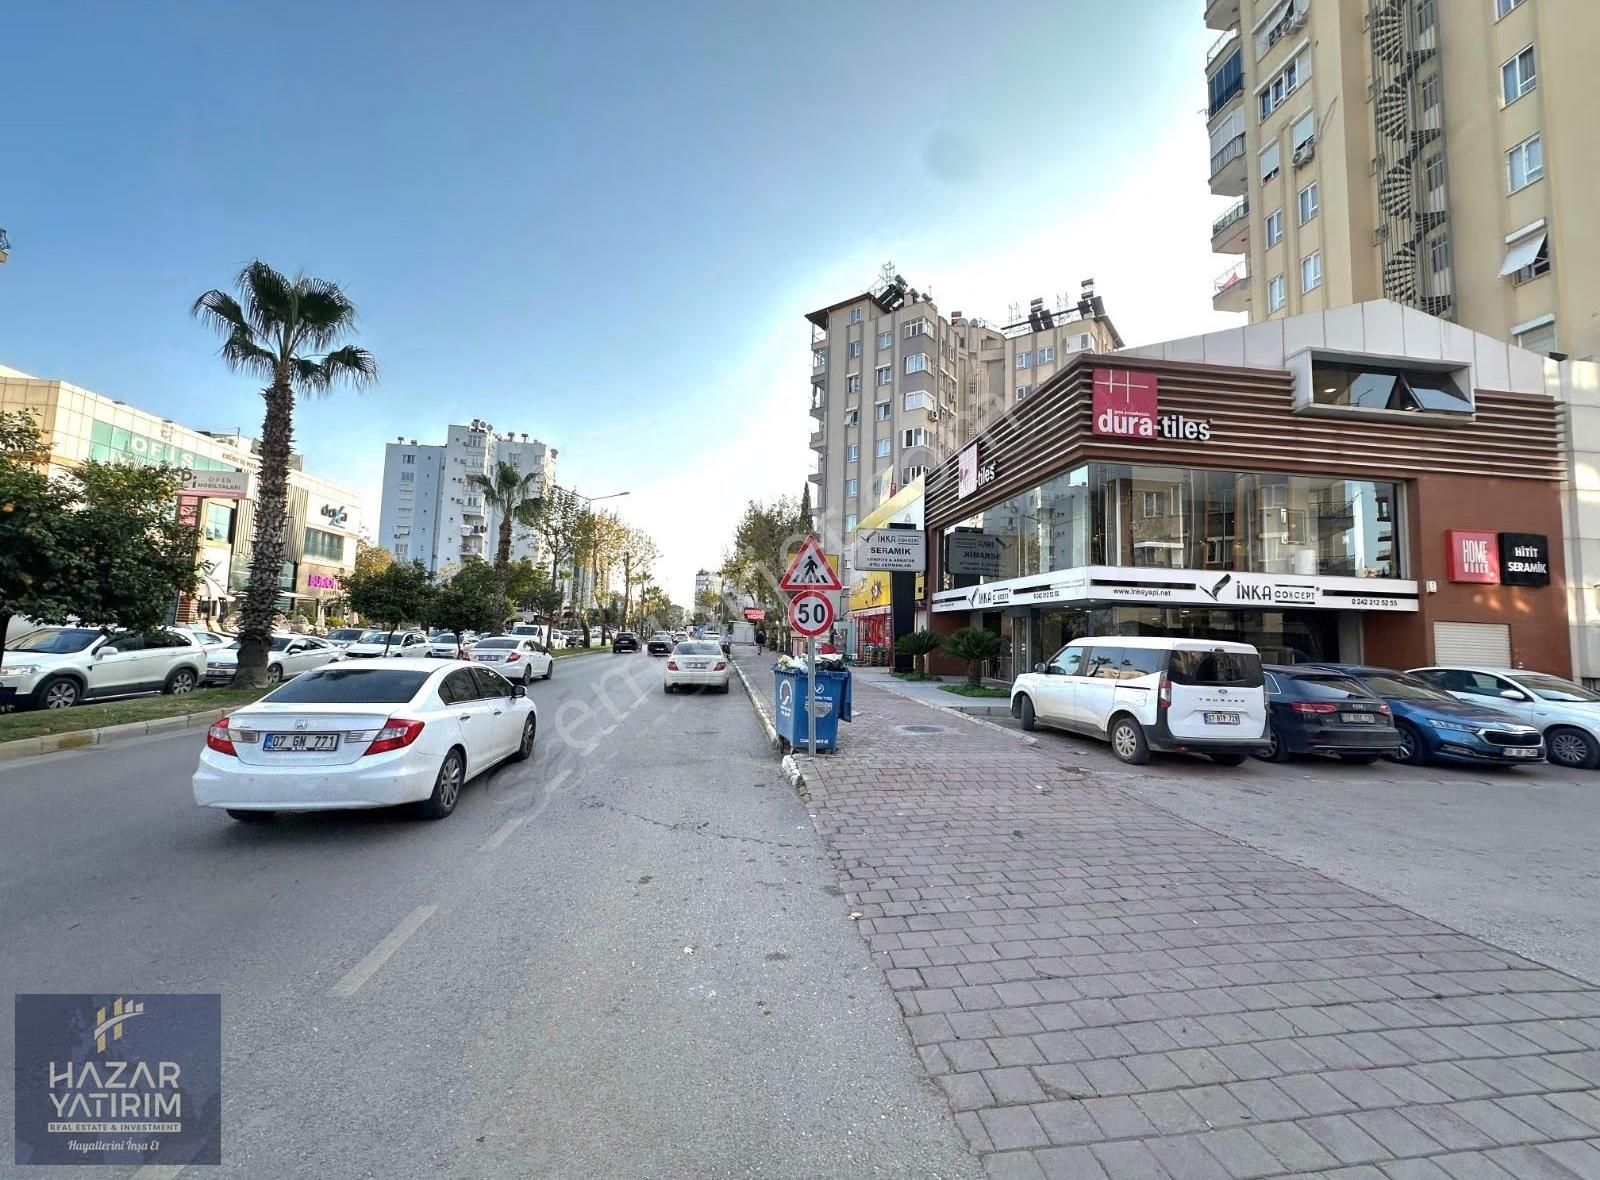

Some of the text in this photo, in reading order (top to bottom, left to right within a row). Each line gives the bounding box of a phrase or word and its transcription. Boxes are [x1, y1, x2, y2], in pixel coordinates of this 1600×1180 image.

[1463, 539, 1489, 563] HOME
[1515, 546, 1539, 557] HİTİT
[1508, 561, 1547, 573] SERAMİK
[1236, 580, 1315, 600] İNKA CONCEPT
[798, 603, 826, 624] 50
[272, 736, 334, 747] 07 GN 771
